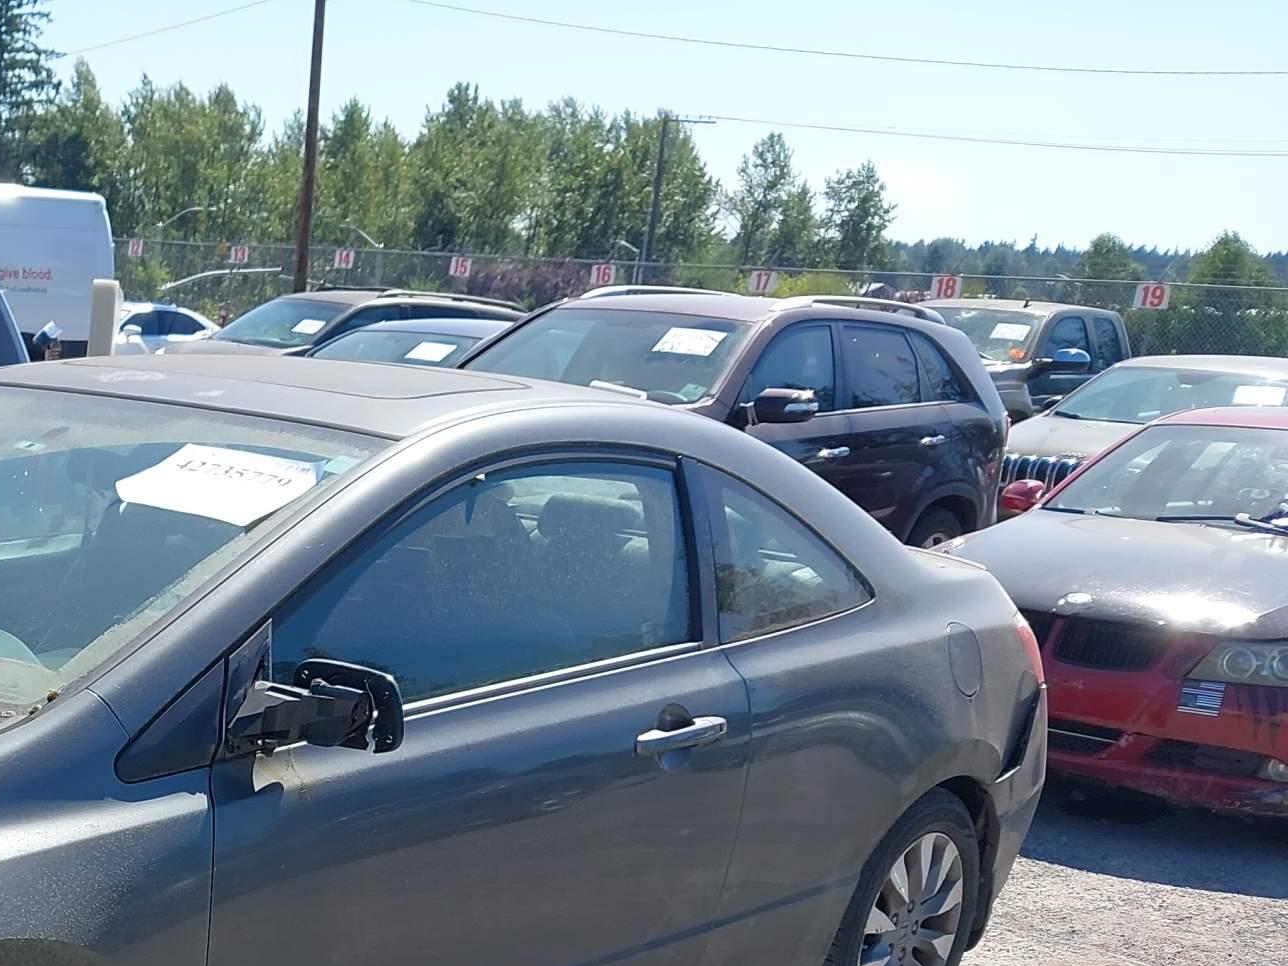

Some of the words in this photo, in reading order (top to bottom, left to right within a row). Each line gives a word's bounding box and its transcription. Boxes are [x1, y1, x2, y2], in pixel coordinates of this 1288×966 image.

[234, 247, 246, 262] 13
[338, 249, 351, 268] 14
[22, 266, 54, 281] blood.
[454, 257, 468, 275] 15
[595, 264, 611, 284] 16
[755, 271, 772, 291] 17
[935, 277, 958, 298] 18
[1141, 284, 1166, 307] 19
